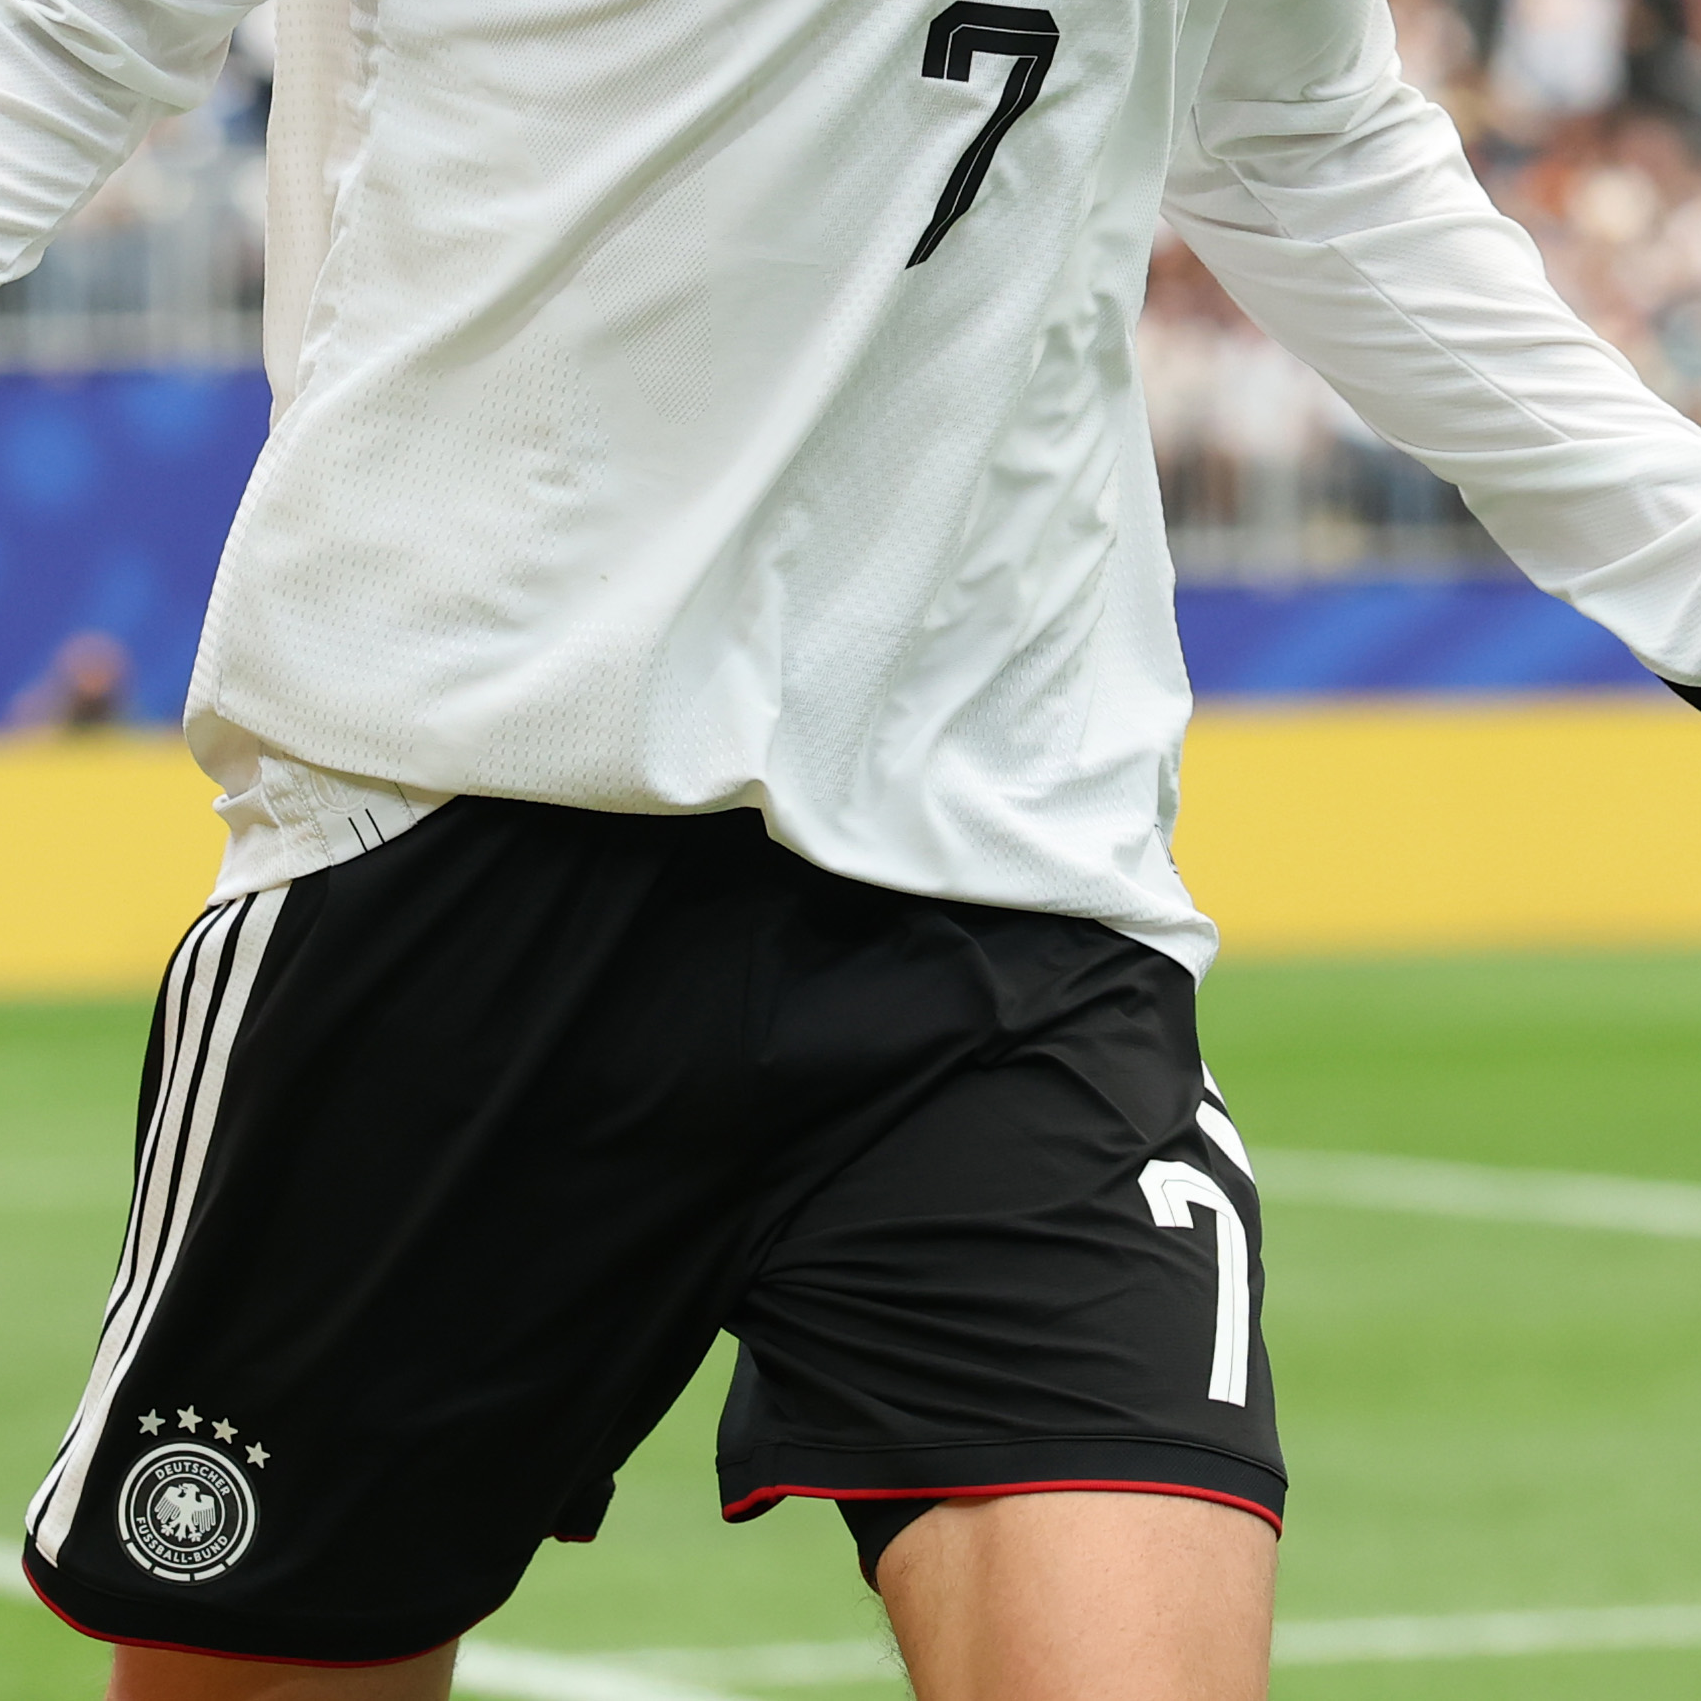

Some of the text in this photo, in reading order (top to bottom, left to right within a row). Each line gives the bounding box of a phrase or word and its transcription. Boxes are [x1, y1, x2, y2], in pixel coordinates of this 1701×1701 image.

[904, 0, 1060, 270] 7
[1137, 1158, 1250, 1408] 7
[135, 1516, 229, 1563] FUSSBALL-BUND
[154, 1461, 231, 1497] DEUTSCHER
